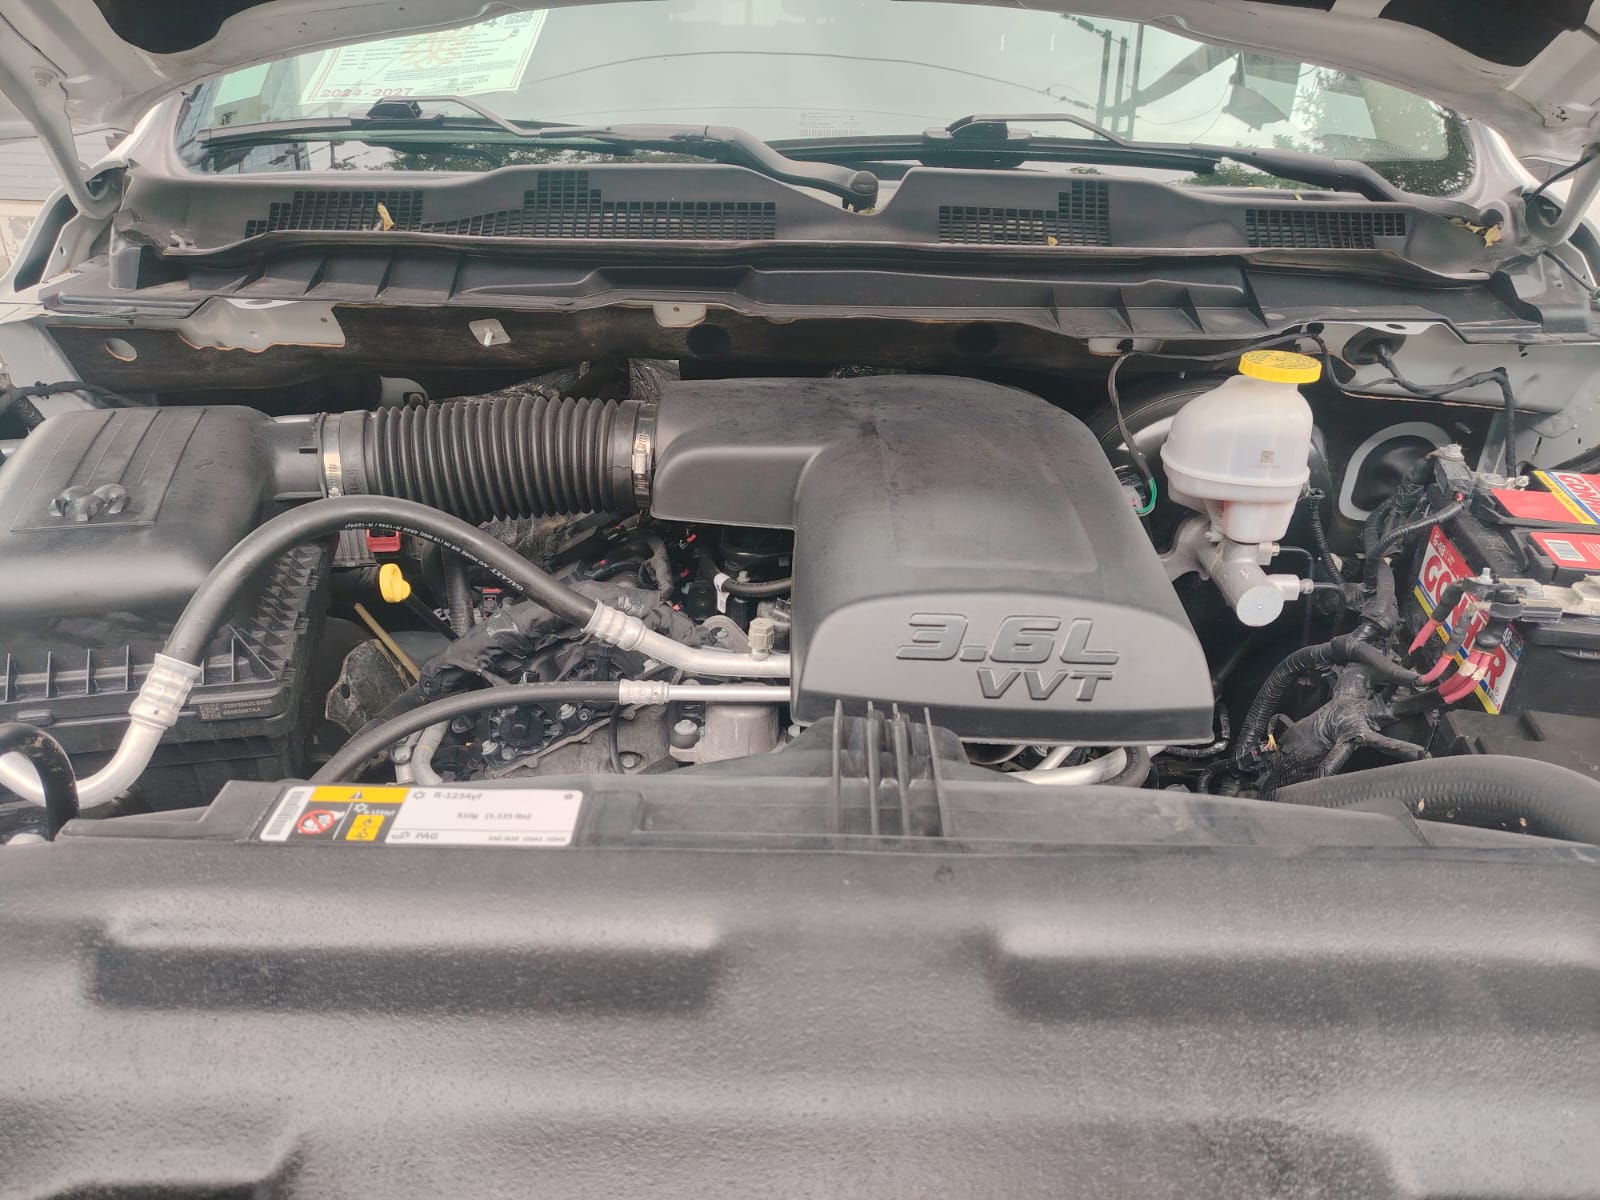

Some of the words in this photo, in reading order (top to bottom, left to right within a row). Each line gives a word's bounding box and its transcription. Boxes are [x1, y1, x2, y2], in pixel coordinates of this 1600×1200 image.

[488, 568, 524, 591] GALAXY
[896, 612, 1121, 666] 3.6L
[1424, 555, 1506, 690] GOHR
[976, 667, 1113, 702] VVT
[433, 791, 483, 801] R-1234yf
